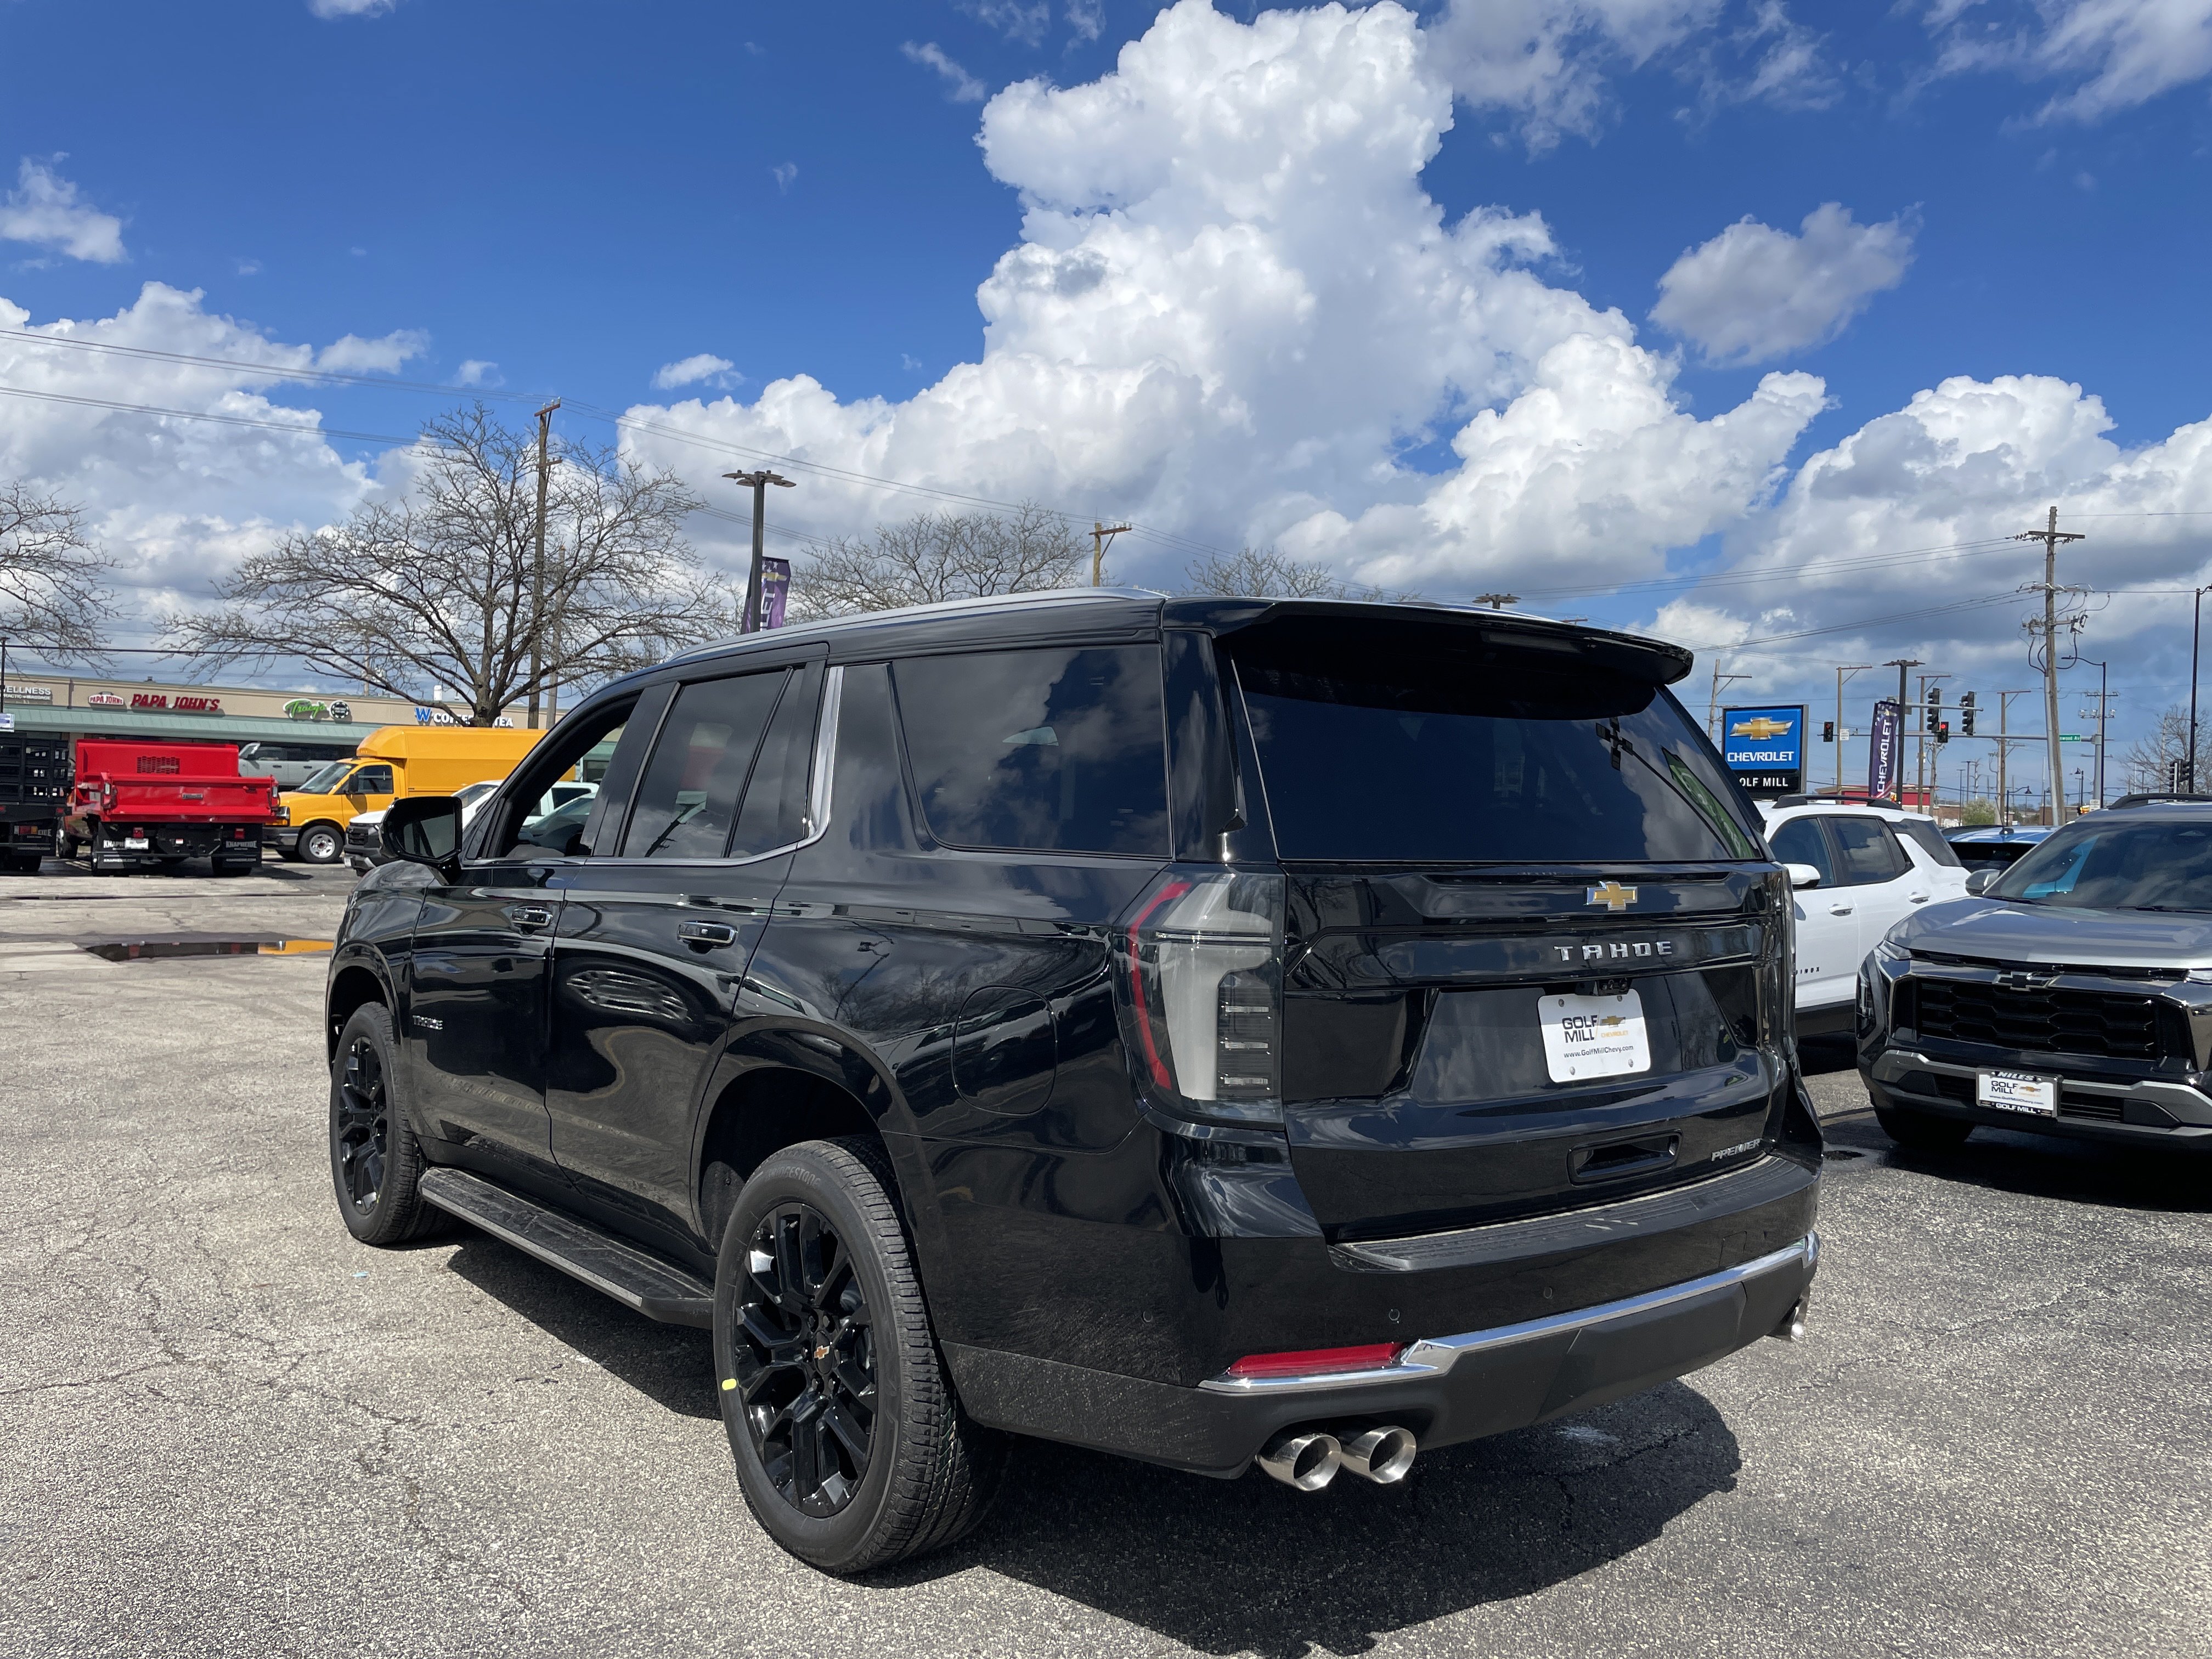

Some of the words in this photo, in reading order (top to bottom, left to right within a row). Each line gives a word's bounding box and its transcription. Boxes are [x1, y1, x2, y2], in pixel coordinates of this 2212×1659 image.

[131, 693, 167, 708] PAPA
[172, 696, 220, 711] JOHN'S
[415, 708, 431, 721] W
[1727, 751, 1795, 762] CHEVROLET
[1877, 719, 1892, 792] CHEVROLET
[1739, 777, 1759, 787] OLF
[1763, 777, 1788, 787] MILL
[1554, 941, 1673, 961] TAHOE
[1562, 1015, 1598, 1030] GOLF
[1564, 1029, 1595, 1043] MILL
[1564, 1045, 1634, 1058] www.GolfMillChevy.com
[1997, 1071, 2034, 1081] NILES
[1991, 1080, 2018, 1089] GOLF
[1991, 1086, 2013, 1094] MILL
[1711, 1138, 1762, 1161] PREMIER
